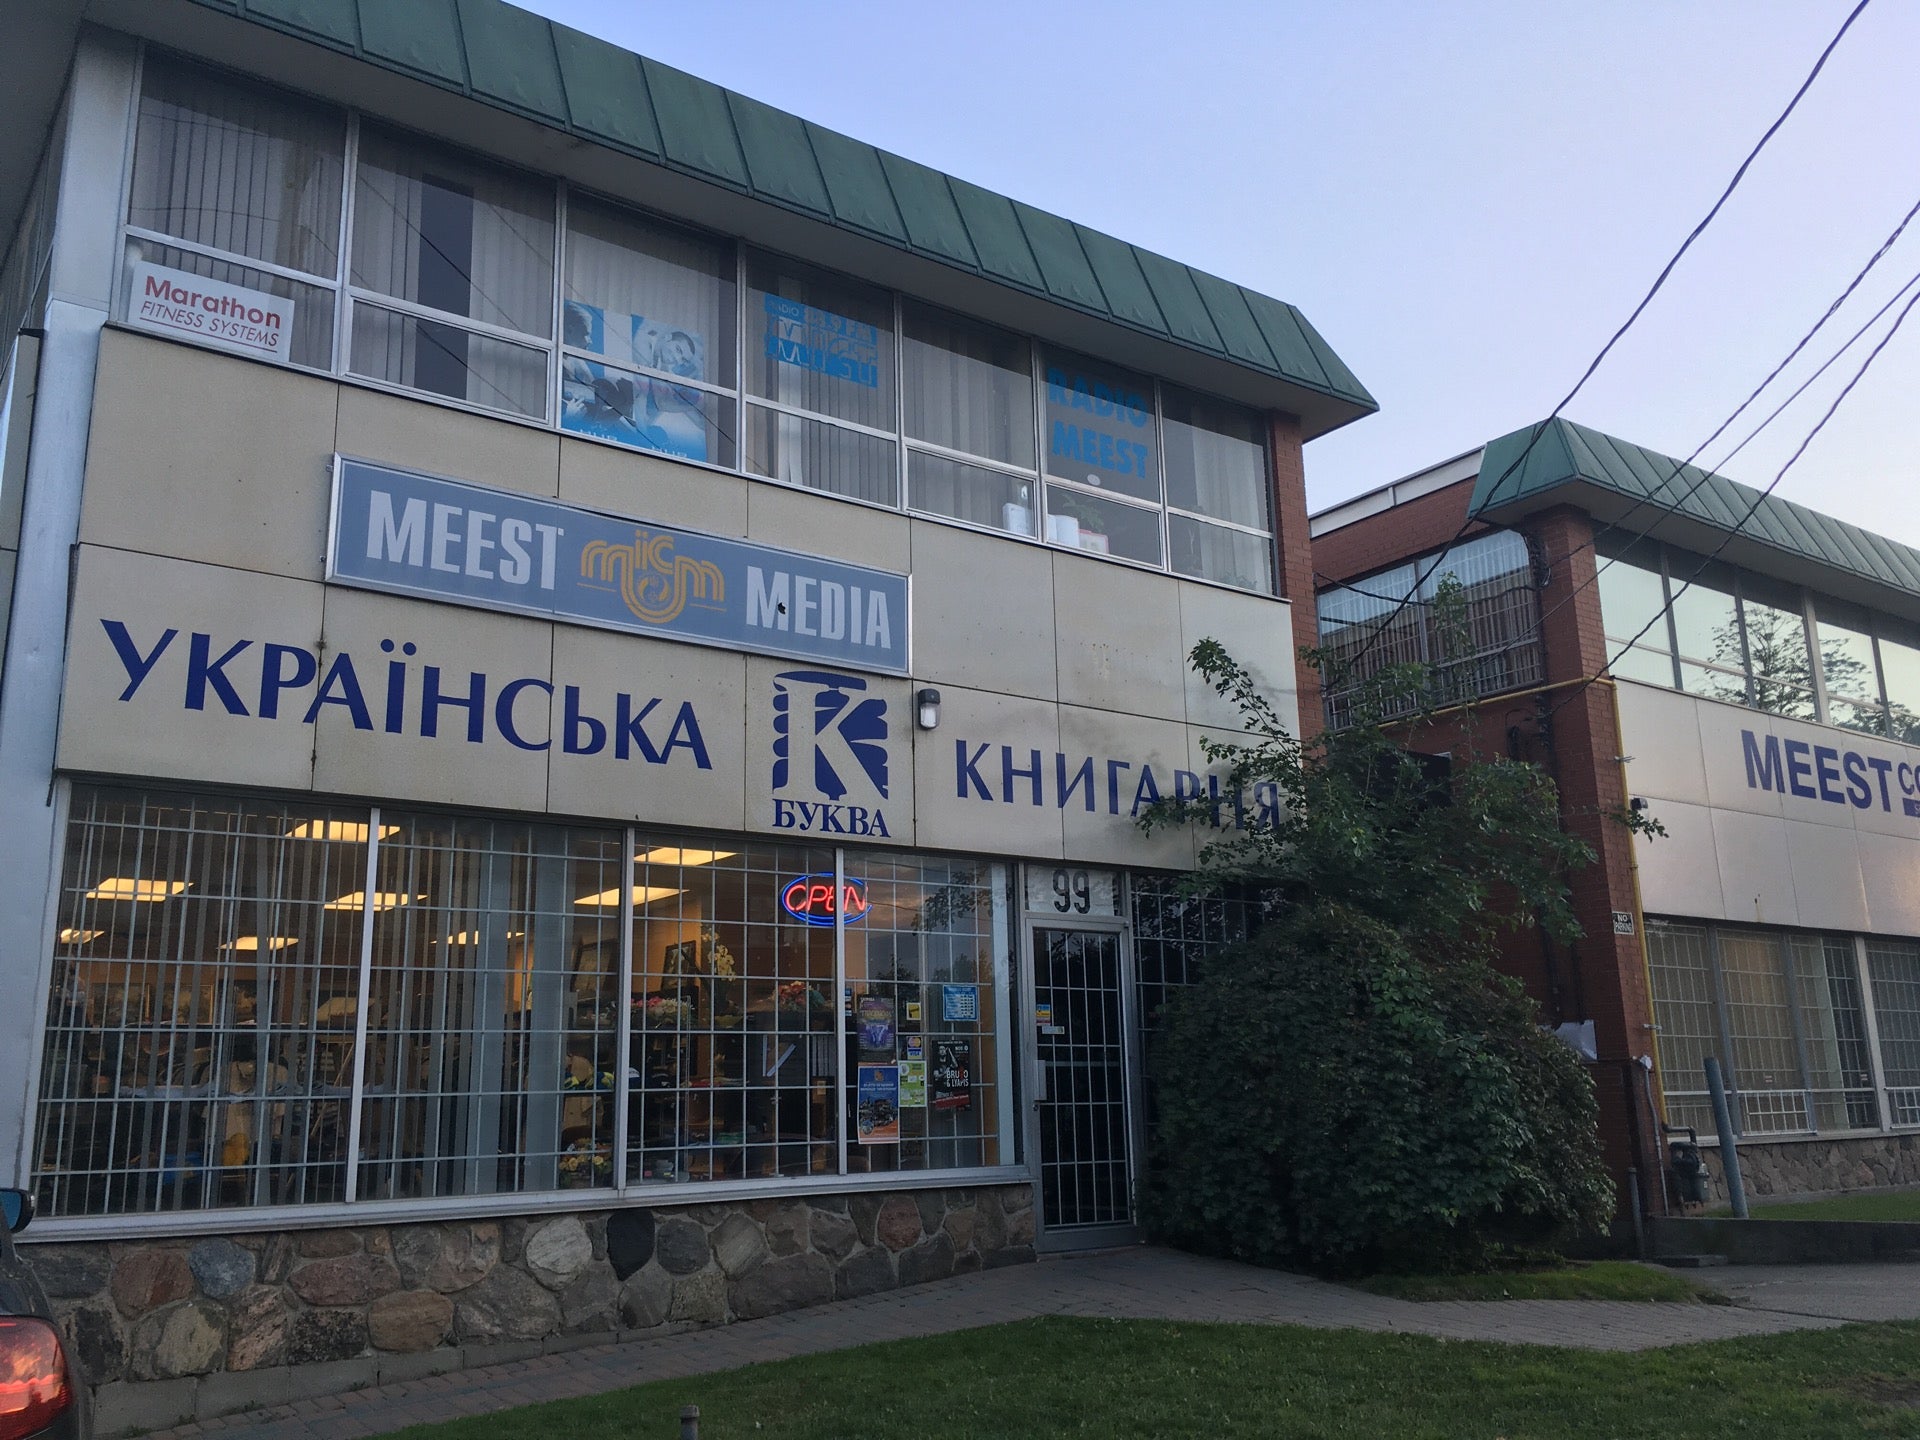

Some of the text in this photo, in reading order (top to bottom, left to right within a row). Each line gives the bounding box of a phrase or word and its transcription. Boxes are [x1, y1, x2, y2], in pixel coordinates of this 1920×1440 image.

[140, 300, 279, 347] FITNESS SYSTEMS
[145, 275, 281, 329] Marathon
[1047, 367, 1148, 428] RADIO
[1052, 420, 1148, 480] MEEST
[367, 490, 565, 591] MEEST
[746, 565, 891, 649] MEDIA
[100, 619, 1280, 831] УКРАЇНСЬКА КНИГАРНЯ
[1741, 729, 1892, 813] MEEST
[772, 799, 891, 838] БУКВА
[1052, 869, 1090, 914] 99
[1617, 914, 1628, 922] NO
